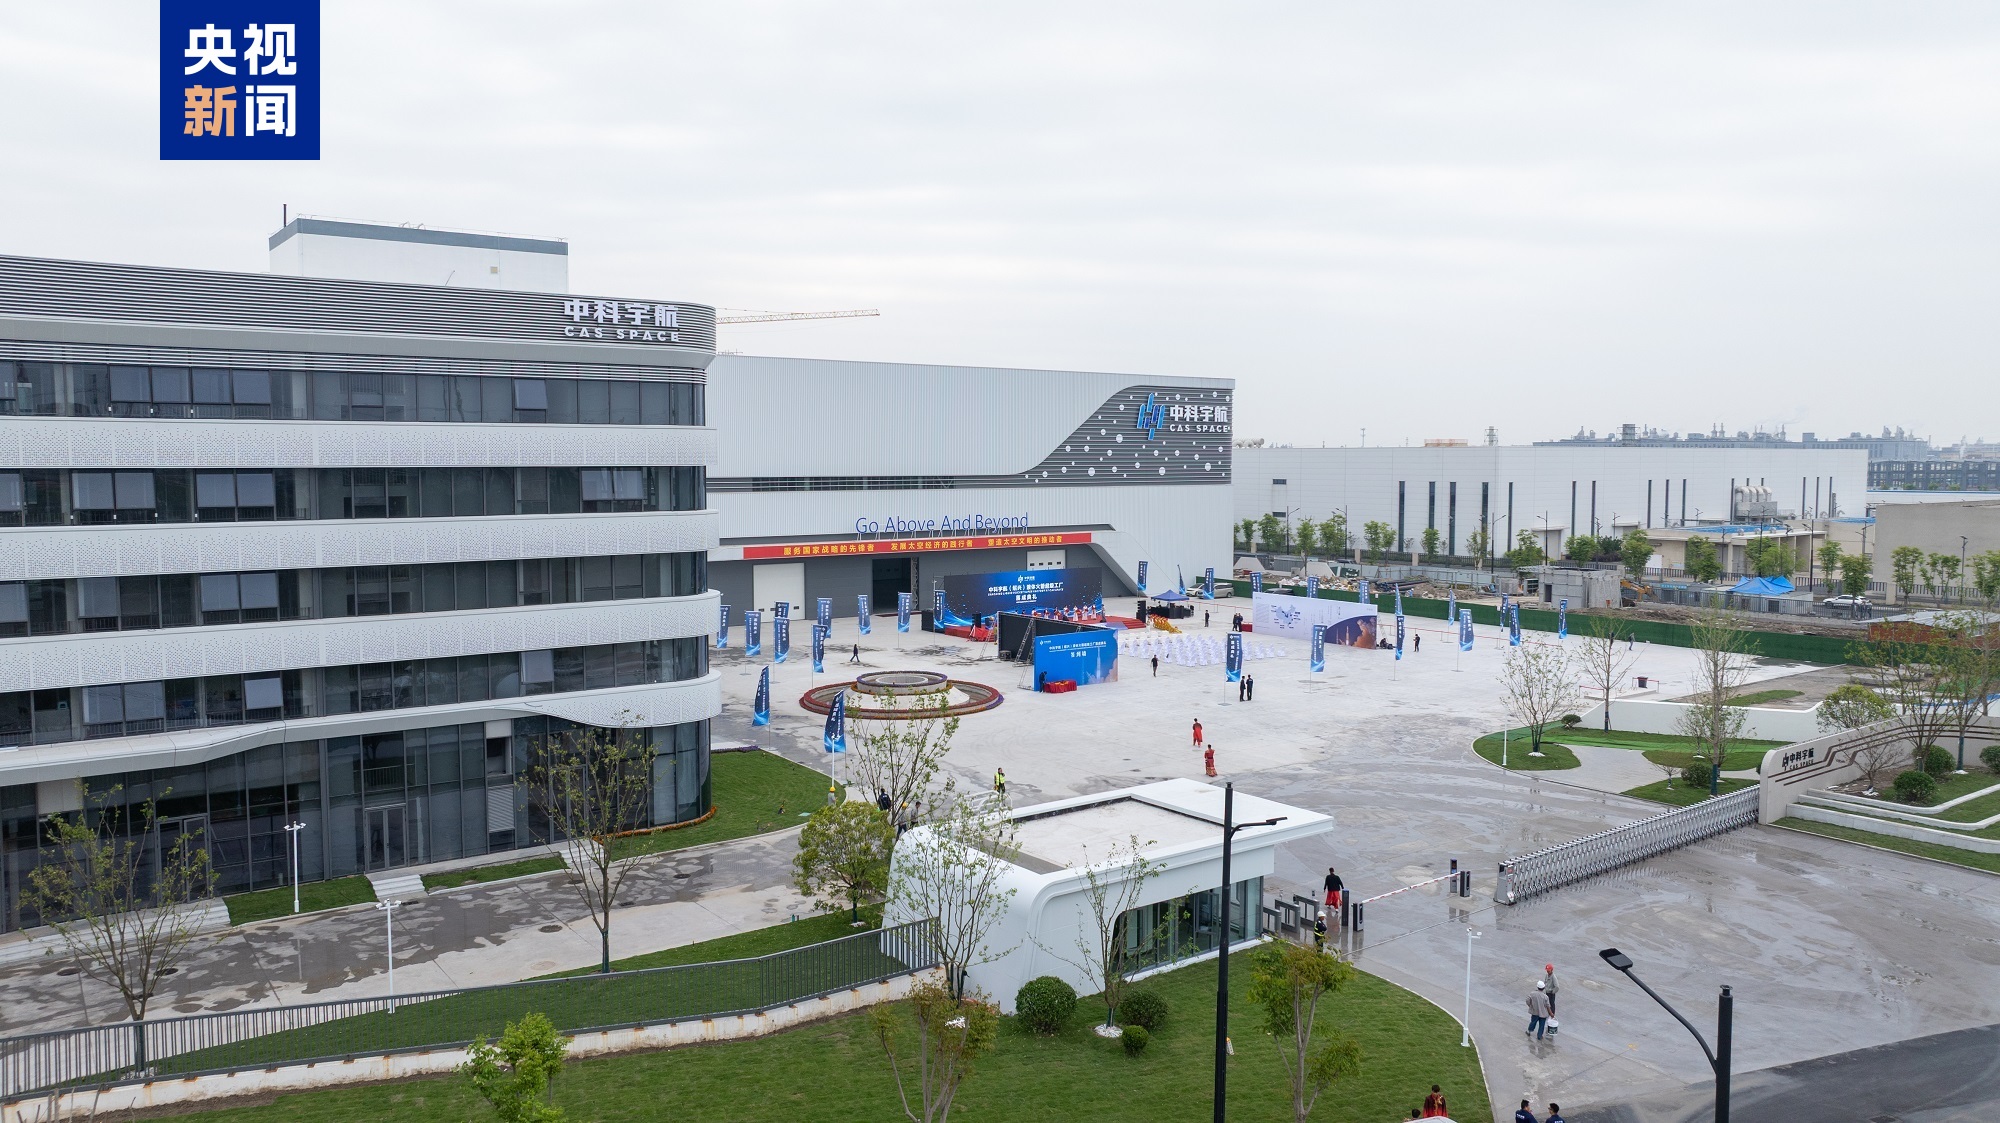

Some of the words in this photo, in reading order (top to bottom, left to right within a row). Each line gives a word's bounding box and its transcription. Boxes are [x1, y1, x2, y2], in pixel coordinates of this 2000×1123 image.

[564, 299, 679, 328] 中科宇航
[564, 326, 603, 338] CAS
[616, 328, 679, 342] SPACE
[1169, 404, 1228, 422] 中科宇航
[1169, 424, 1190, 432] CAS
[1196, 424, 1228, 433] SPACE
[855, 517, 879, 534] Go
[884, 515, 935, 533] Above
[940, 514, 970, 531] And
[975, 511, 1029, 534] Beyond
